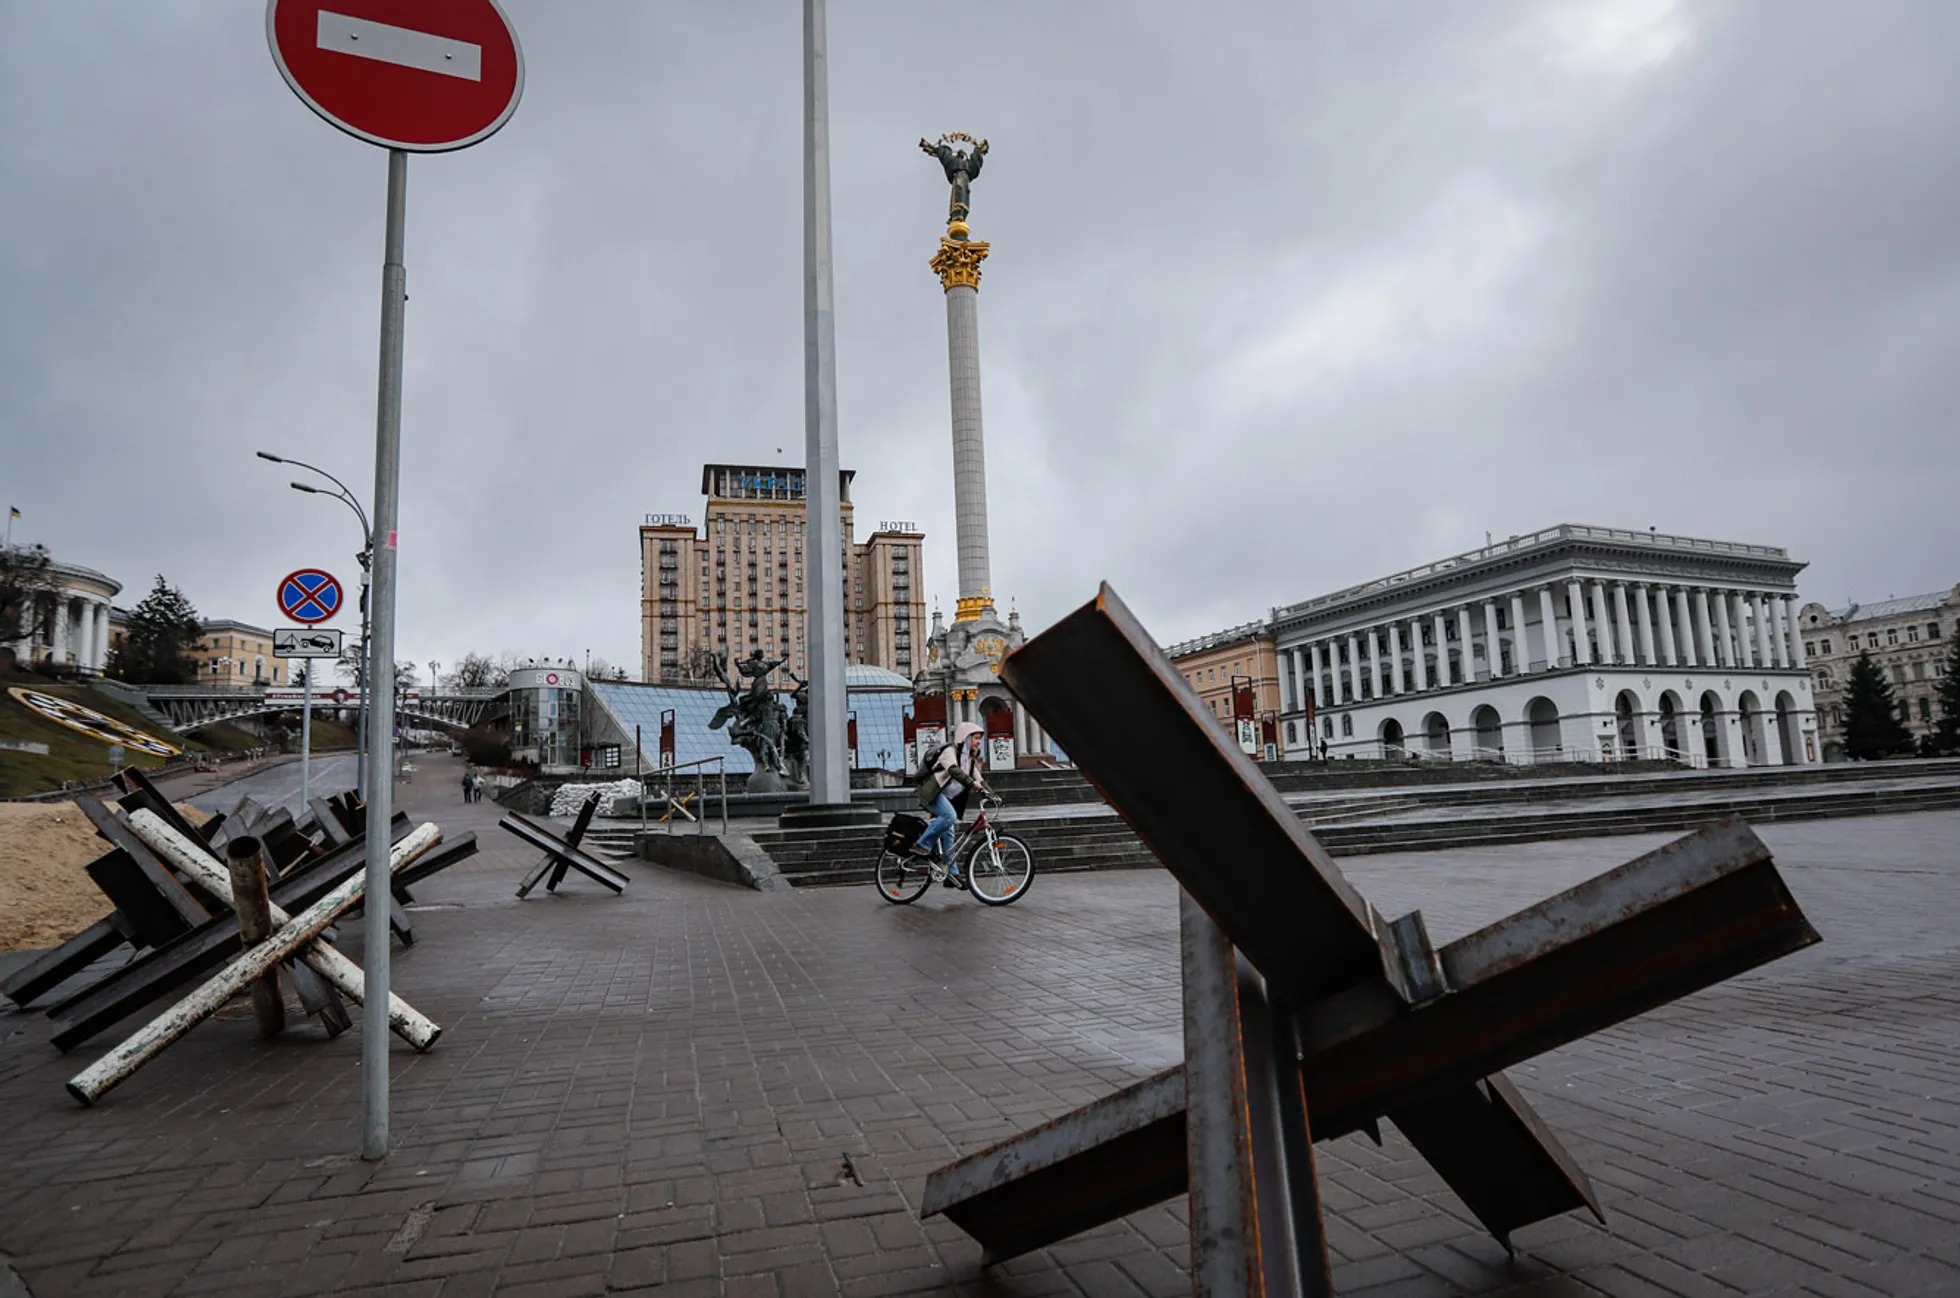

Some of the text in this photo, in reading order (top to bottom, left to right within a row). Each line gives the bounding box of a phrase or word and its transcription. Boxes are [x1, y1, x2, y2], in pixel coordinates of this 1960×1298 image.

[645, 513, 691, 525] ГОТЕЛЬ
[880, 520, 918, 531] HOTEL
[535, 672, 575, 687] GLOBUS
